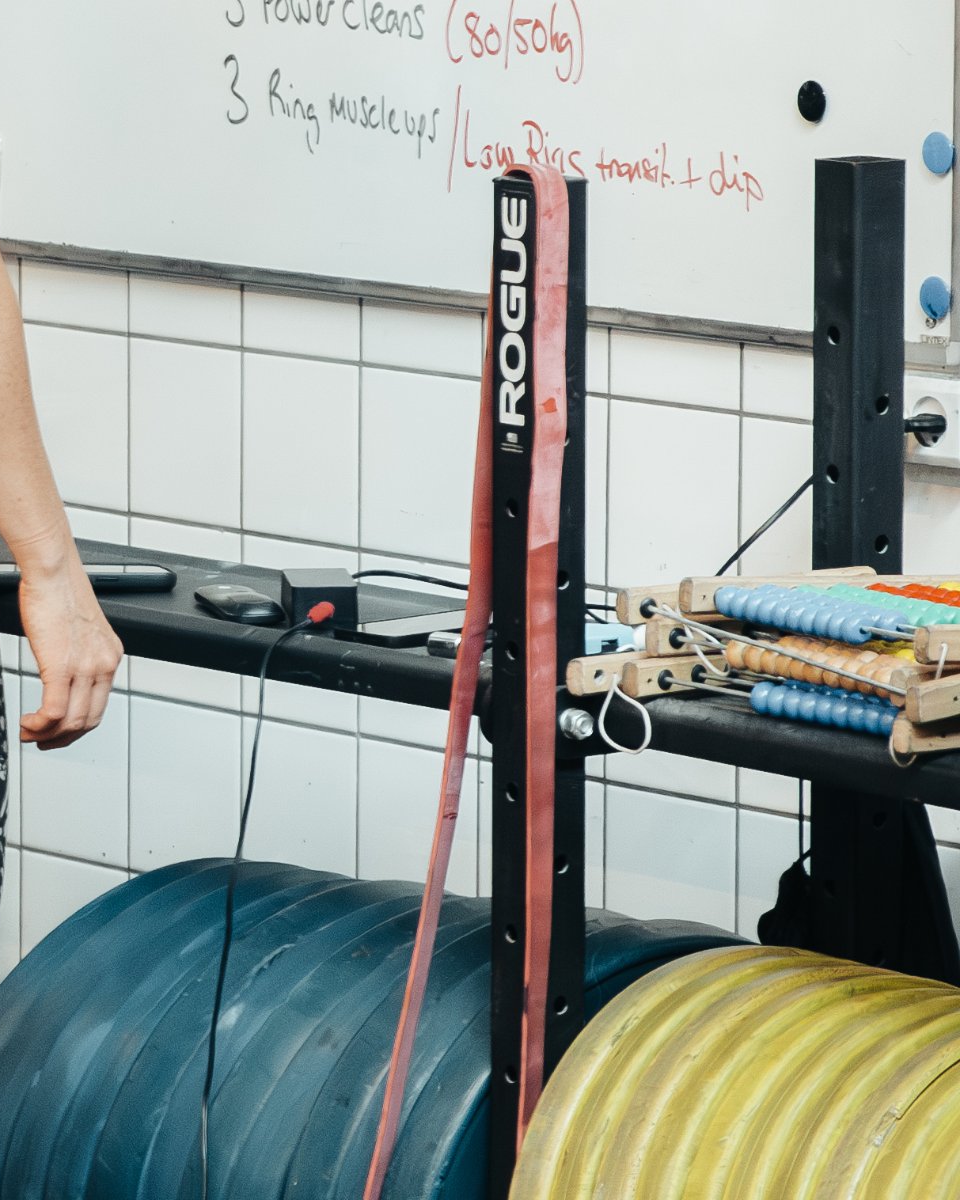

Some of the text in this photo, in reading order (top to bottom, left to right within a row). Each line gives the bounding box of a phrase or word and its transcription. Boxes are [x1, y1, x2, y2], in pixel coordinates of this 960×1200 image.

[223, 53, 250, 126] 3
[268, 67, 321, 156] Ring
[499, 195, 528, 427] ROGUE
